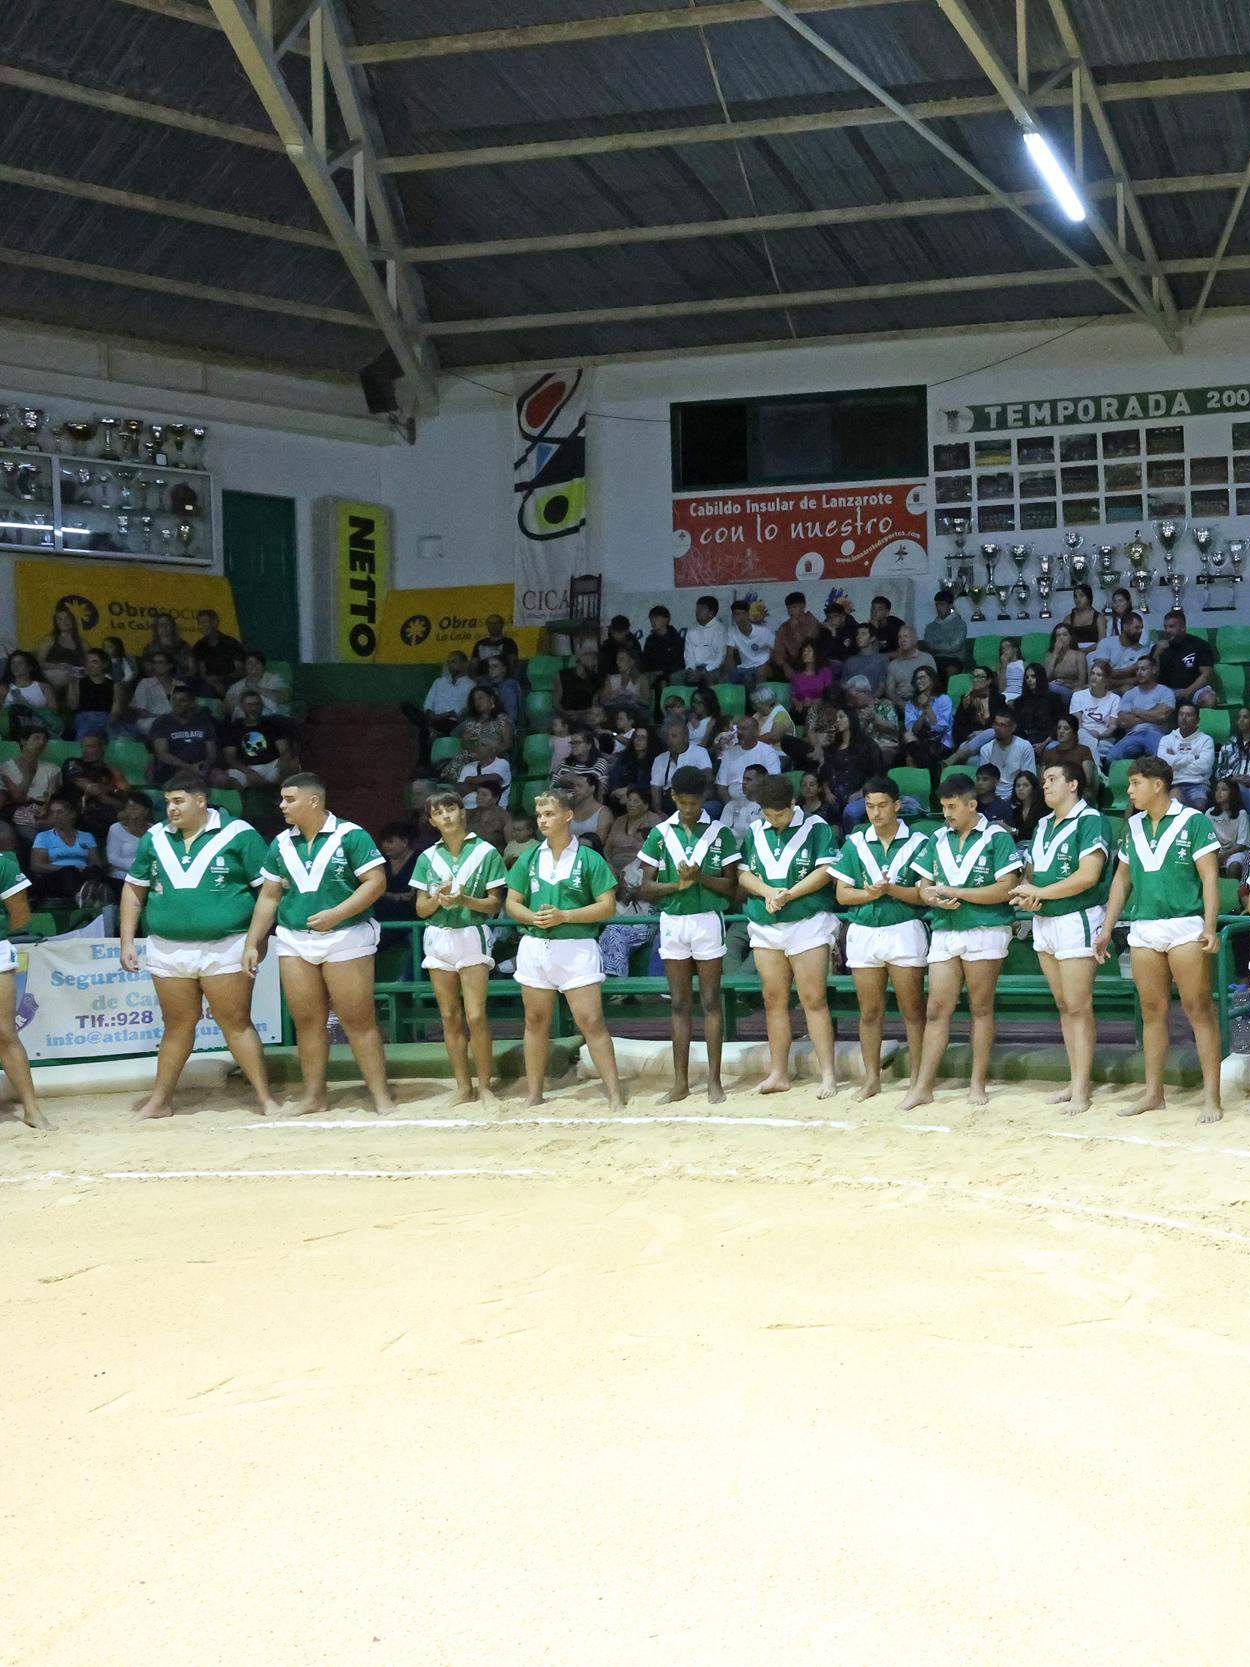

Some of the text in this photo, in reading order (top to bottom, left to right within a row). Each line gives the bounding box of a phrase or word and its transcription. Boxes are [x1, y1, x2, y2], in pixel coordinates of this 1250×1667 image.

[985, 391, 1192, 430] TEMPORADA
[690, 492, 893, 517] Cabildo Insular de Lanzarote
[700, 507, 893, 544] con lo nuestro
[349, 515, 376, 657] NETTO
[91, 995, 119, 1011] de
